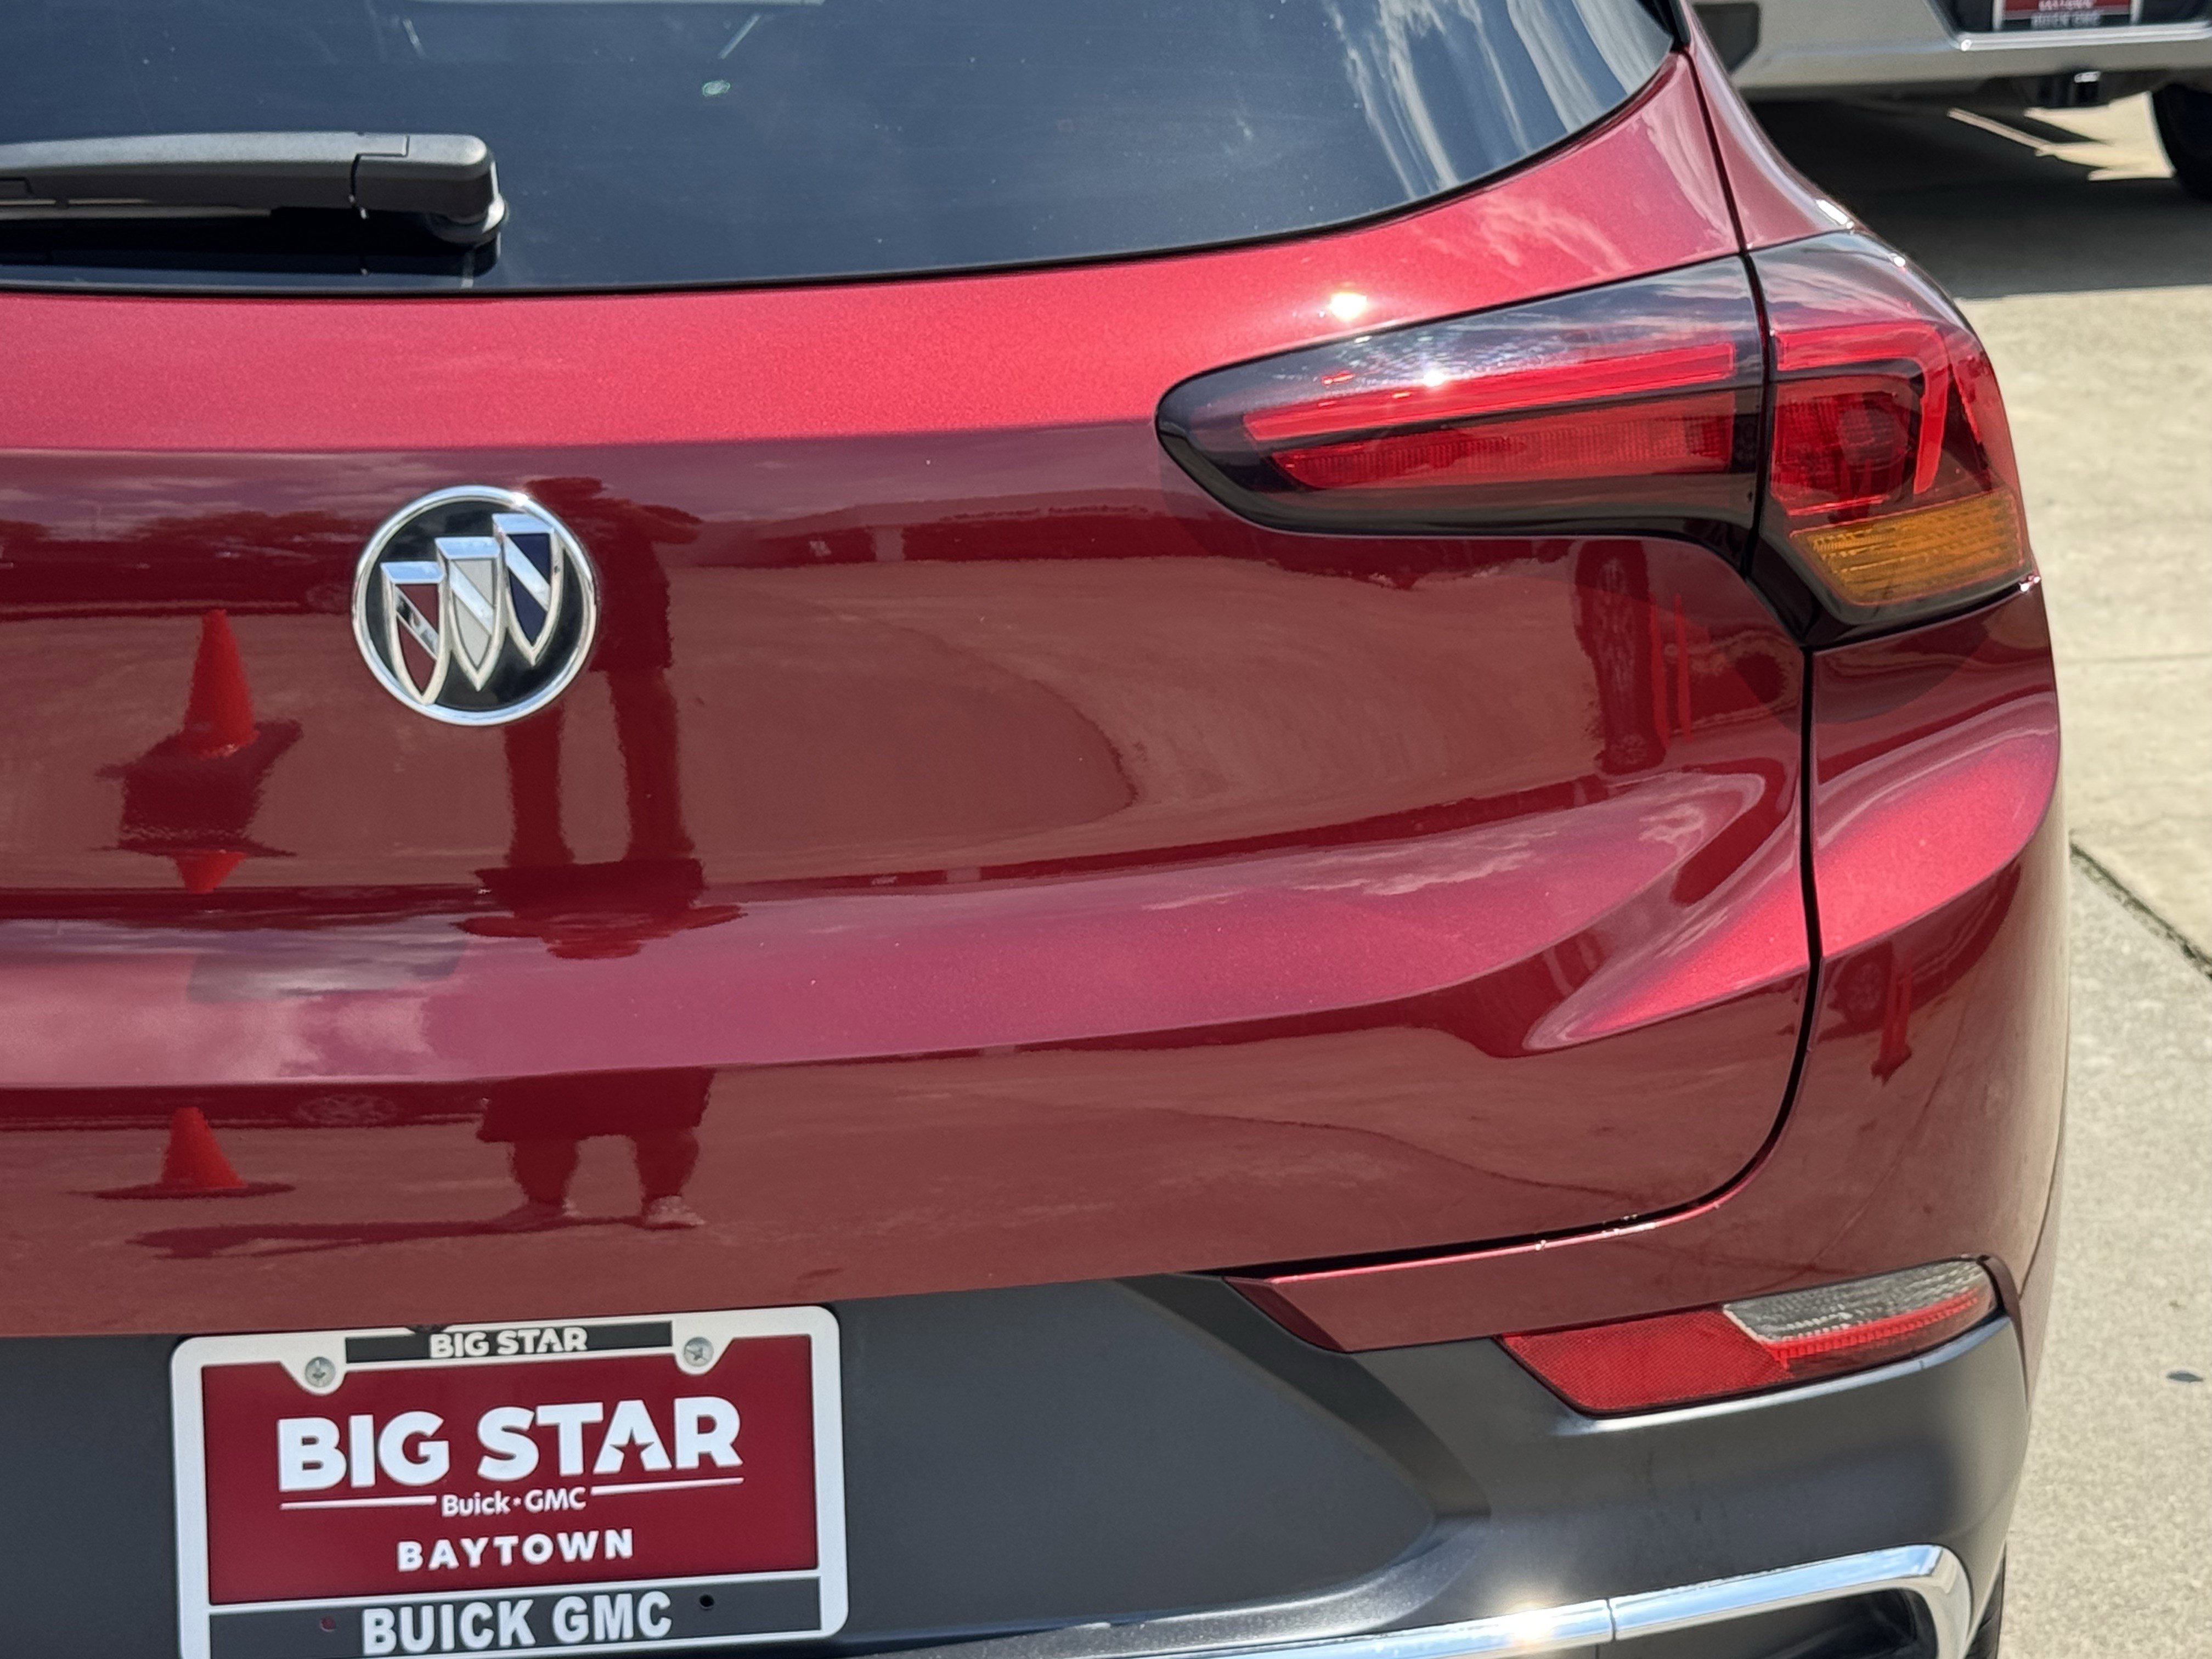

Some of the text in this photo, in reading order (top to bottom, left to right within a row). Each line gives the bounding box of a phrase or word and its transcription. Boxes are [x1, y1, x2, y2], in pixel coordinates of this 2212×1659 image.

[429, 1327, 589, 1358] BIG STAR
[278, 1397, 743, 1492] BIG STAR
[398, 1528, 633, 1571] BAYTOWN
[363, 1592, 672, 1655] BUICK GMC
